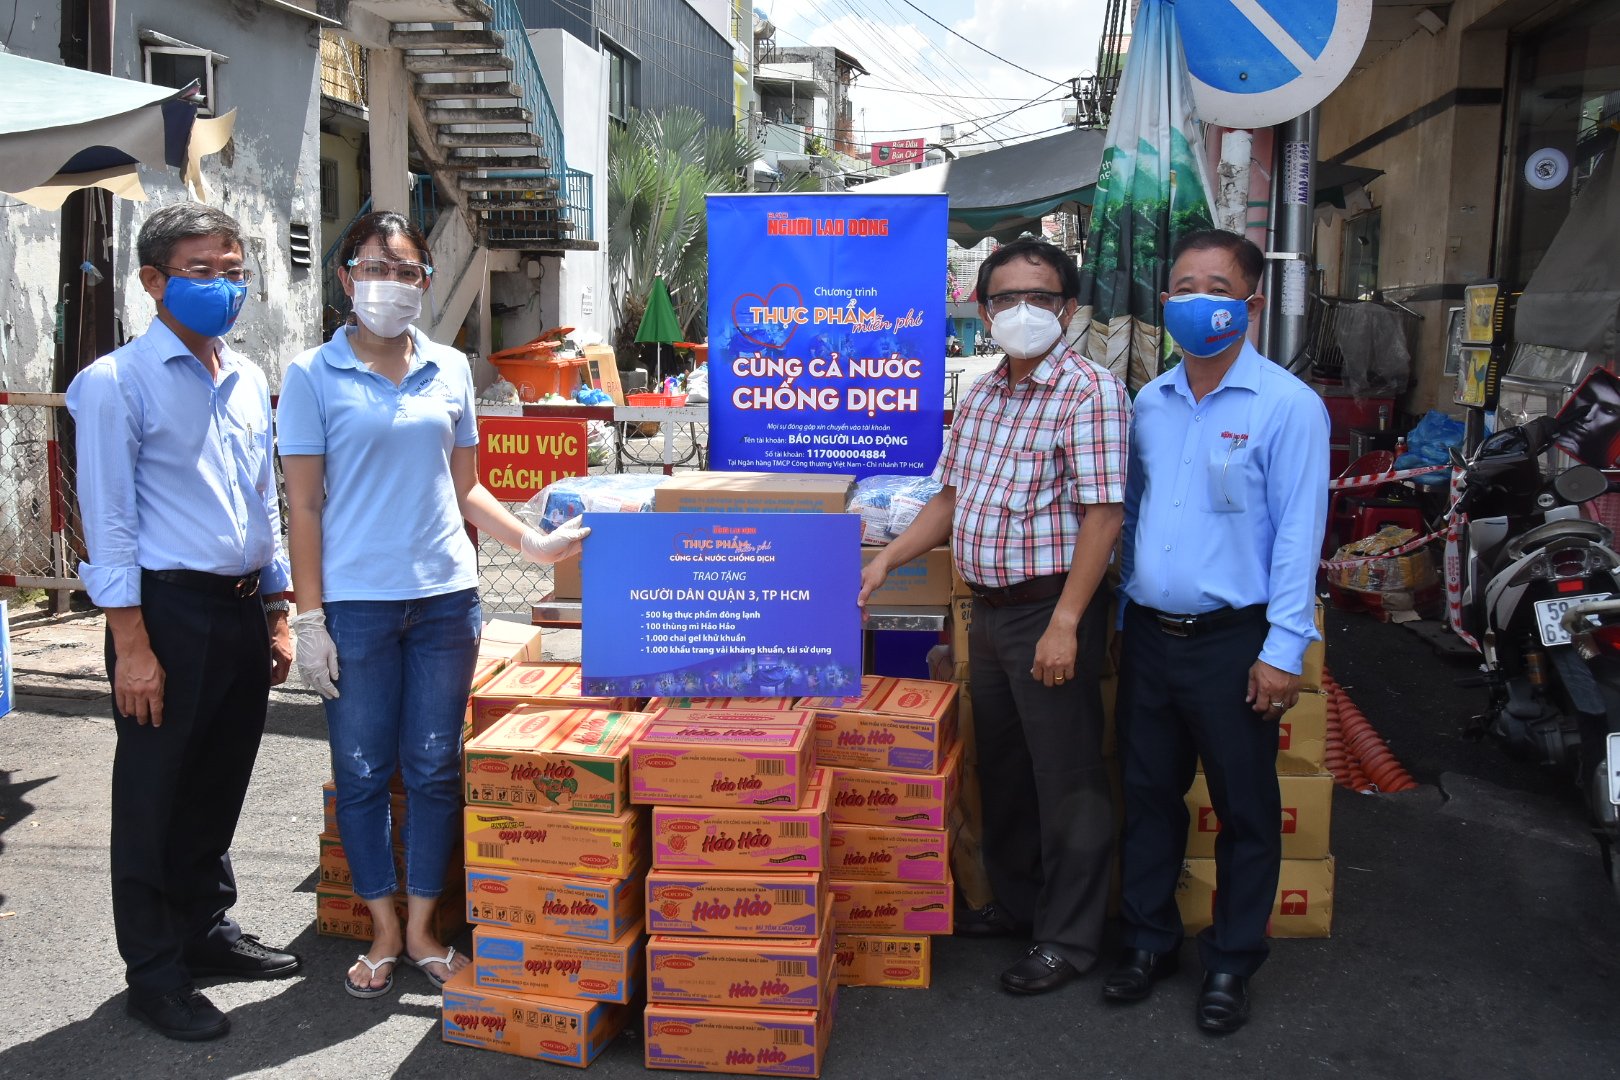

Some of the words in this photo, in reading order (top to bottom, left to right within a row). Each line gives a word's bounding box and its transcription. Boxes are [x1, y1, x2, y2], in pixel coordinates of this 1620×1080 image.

[768, 217, 812, 236] NGƯỜI
[816, 218, 844, 236] LAO
[848, 217, 889, 237] ĐỘNG
[814, 286, 853, 298] Chương
[854, 287, 878, 297] trình
[750, 306, 808, 328] THỰC
[814, 298, 877, 325] PHẨM
[852, 313, 893, 334] miễn
[893, 308, 924, 335] phí
[732, 352, 803, 378] CÙNG
[808, 352, 844, 378] CẢ
[849, 353, 921, 379] NƯỚC
[732, 377, 840, 411] CHỐNG
[847, 388, 918, 418] DỊCH
[488, 434, 530, 454] KHU
[536, 432, 578, 460] VỰC
[788, 432, 811, 444] BÁO
[813, 434, 849, 445] NGƯỜI
[852, 435, 874, 445] LAO
[875, 434, 908, 448] ĐỘNG
[807, 449, 886, 459] 117000004884
[489, 464, 544, 490] CÁCH
[683, 540, 714, 551] THỰC
[670, 554, 692, 562] CÙNG
[692, 554, 704, 562] CẢ
[705, 554, 726, 562] NƯỚC
[728, 552, 756, 562] CHỐNG
[757, 555, 775, 564] DỊCH
[693, 571, 719, 581] TRAO
[720, 570, 747, 583] TẶNG
[630, 588, 673, 600] NGƯỜI
[676, 588, 704, 600] DÂN
[708, 588, 745, 604] QUẬN
[748, 590, 759, 602] 3,
[762, 590, 778, 600] TP
[780, 590, 810, 600] HCM
[646, 610, 661, 618] 500
[662, 610, 673, 620] kg
[674, 610, 693, 620] thực
[694, 610, 718, 620] phẩm
[720, 610, 740, 620] đông
[742, 610, 761, 620] lạnh
[646, 622, 661, 630] 100
[662, 622, 688, 632] thùng
[701, 622, 718, 630] Hảo
[719, 622, 736, 630] Hảo
[646, 634, 668, 642] 1.000
[670, 634, 687, 642] chai
[688, 634, 701, 644] gel
[702, 634, 720, 642] khử
[720, 633, 746, 642] khuẩn
[646, 646, 668, 654] 1.000
[670, 644, 690, 654] khẩu
[692, 646, 714, 656] trang
[716, 646, 728, 654] vải
[730, 646, 756, 655] kháng
[786, 646, 798, 654] tái
[799, 646, 810, 654] sử
[810, 646, 832, 656] dụng
[838, 728, 866, 746] Hảo
[867, 728, 896, 745] Hảo
[511, 762, 541, 781] Hảo
[543, 760, 575, 779] Hảo
[711, 776, 736, 792] Hảo
[737, 774, 763, 790] Hảo
[835, 788, 865, 807] Hảo
[868, 788, 898, 806] Hảo
[702, 832, 736, 853] Hảo
[737, 828, 772, 850] Hảo
[542, 898, 569, 916] Hảo
[571, 899, 598, 916] Hảo
[692, 898, 731, 922] Hảo
[733, 894, 772, 918] Hảo
[728, 981, 758, 998] Hảo
[760, 978, 790, 996] Hảo
[726, 1048, 755, 1066] Hảo
[757, 1046, 786, 1064] Hảo
